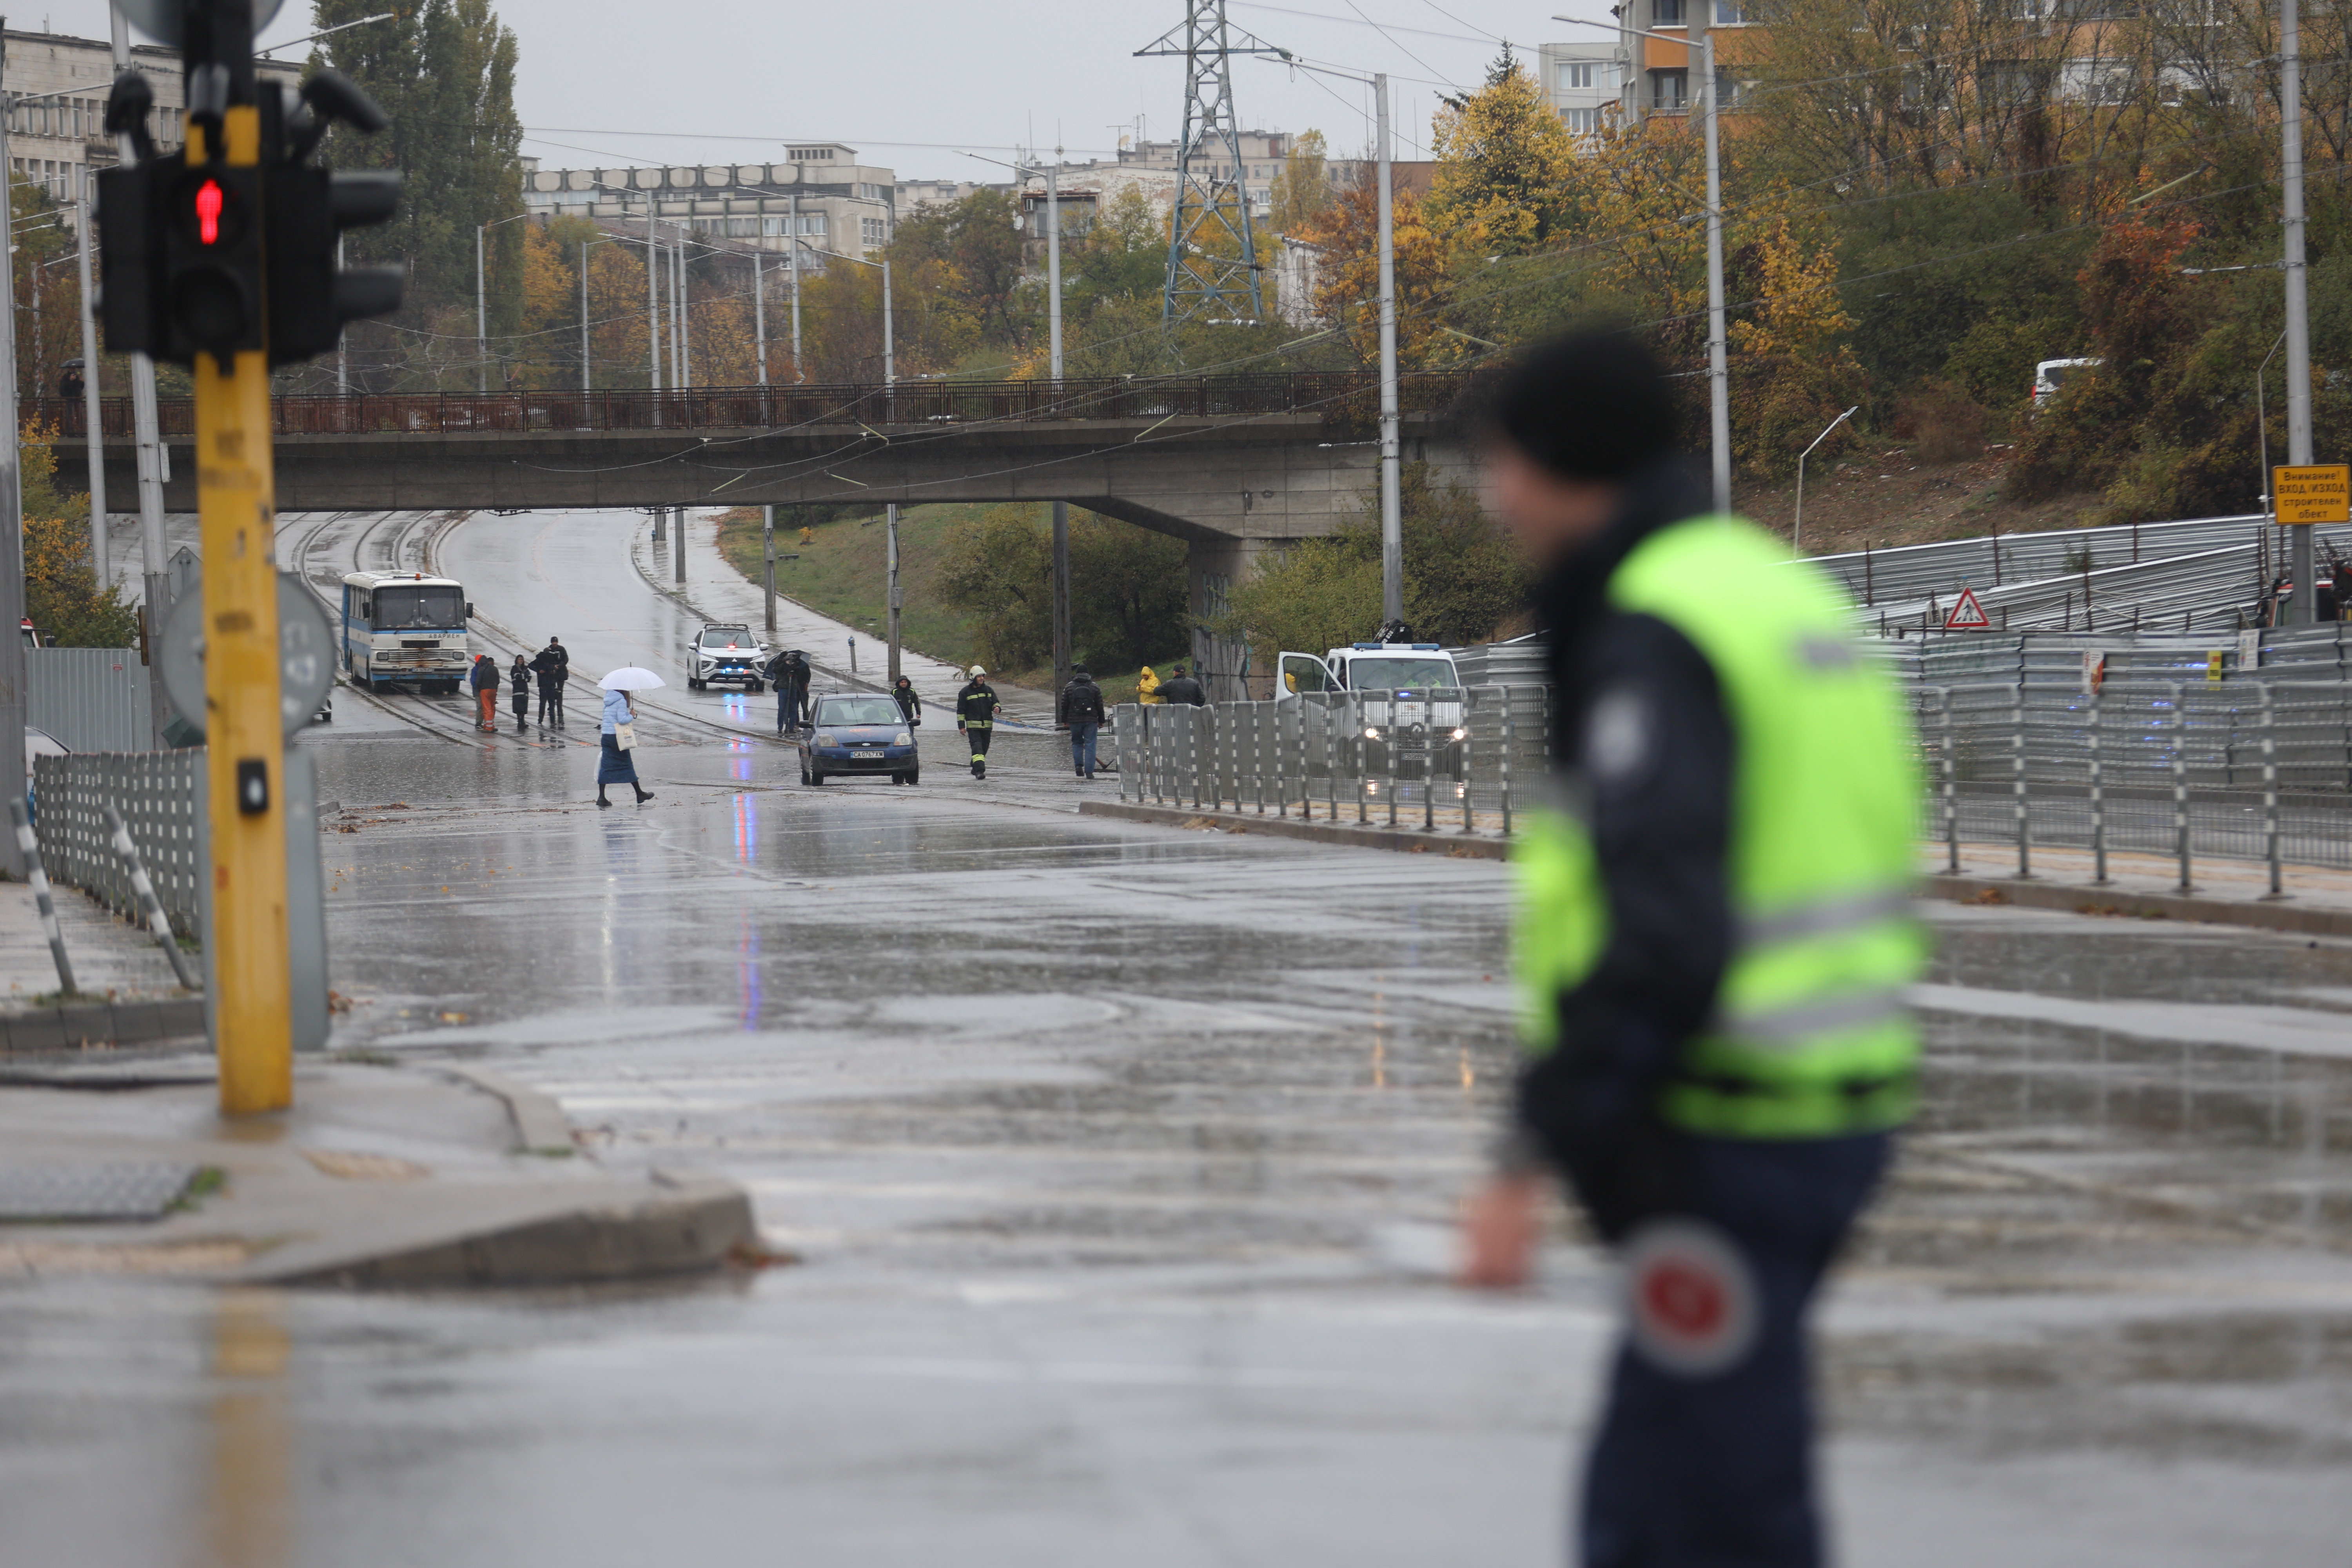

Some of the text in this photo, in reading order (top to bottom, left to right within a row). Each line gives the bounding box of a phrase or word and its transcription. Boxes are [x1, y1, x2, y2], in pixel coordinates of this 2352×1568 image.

[2284, 471, 2340, 481] Внимание!
[2284, 498, 2342, 508] строителен
[2299, 509, 2328, 518] обект
